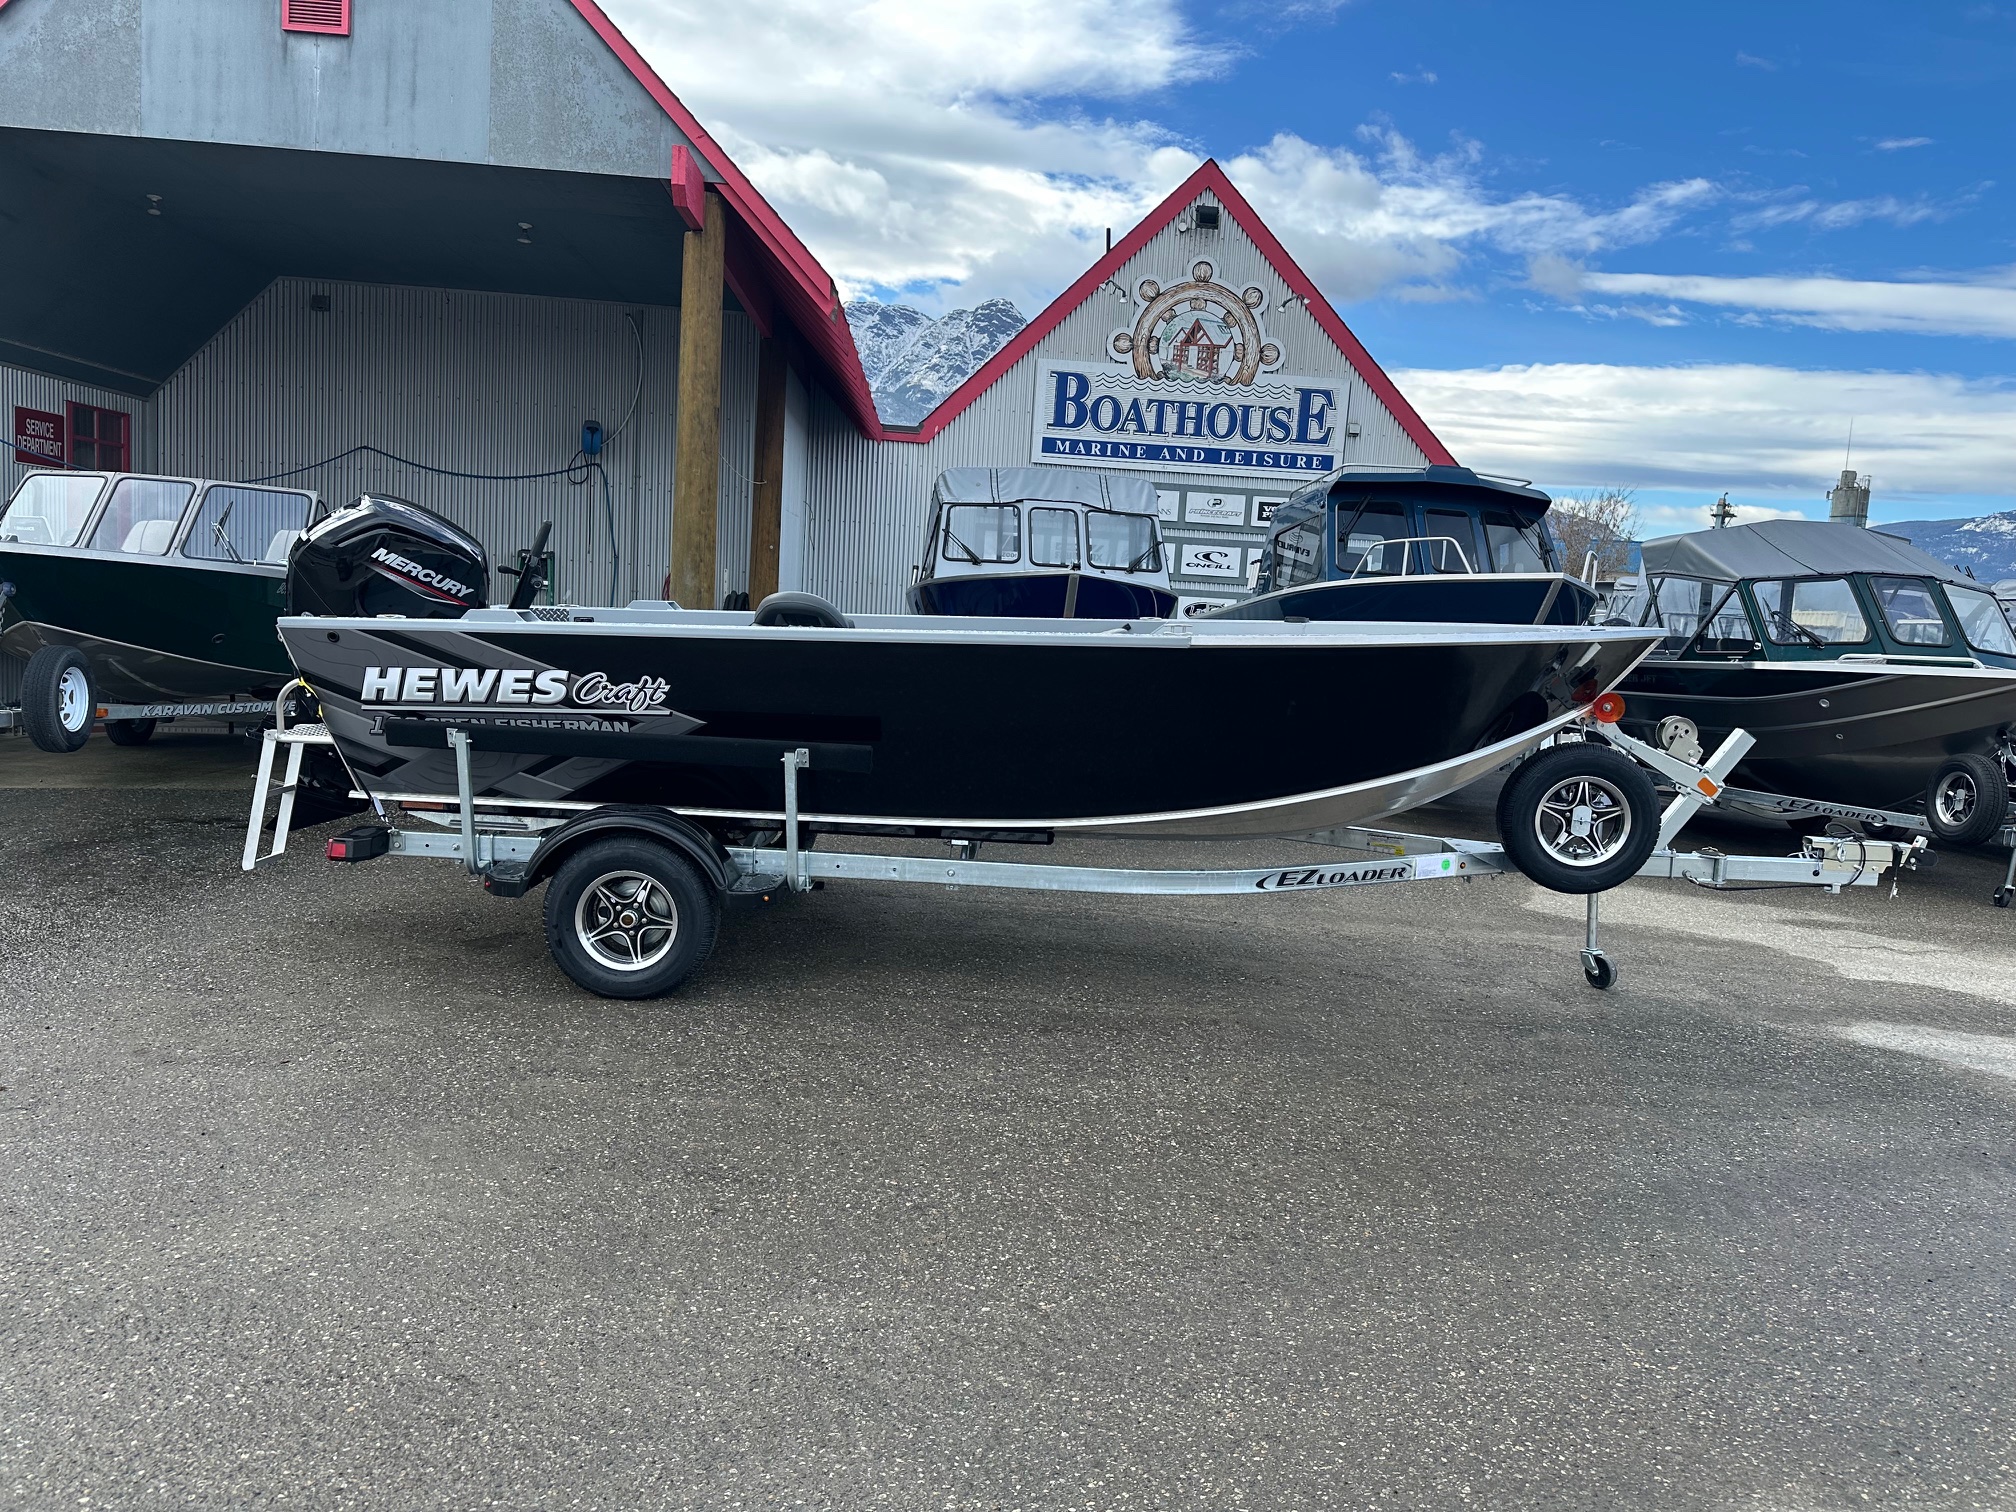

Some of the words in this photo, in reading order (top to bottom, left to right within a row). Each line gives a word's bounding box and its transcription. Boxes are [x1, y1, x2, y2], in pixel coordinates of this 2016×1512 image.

[1047, 371, 1336, 445] BOATHOUSE
[25, 418, 54, 439] SERVICE
[17, 434, 62, 457] DEPARTMENT
[1054, 439, 1147, 459] MARINE
[1159, 446, 1206, 463] AND
[1220, 452, 1324, 470] LEISURE
[370, 547, 475, 598] MERCURY
[360, 666, 570, 705] HEWES
[572, 671, 671, 713] Craft
[141, 704, 214, 717] KARAVAN
[217, 701, 273, 714] CUSTOM
[1275, 867, 1408, 889] EZLOADER
